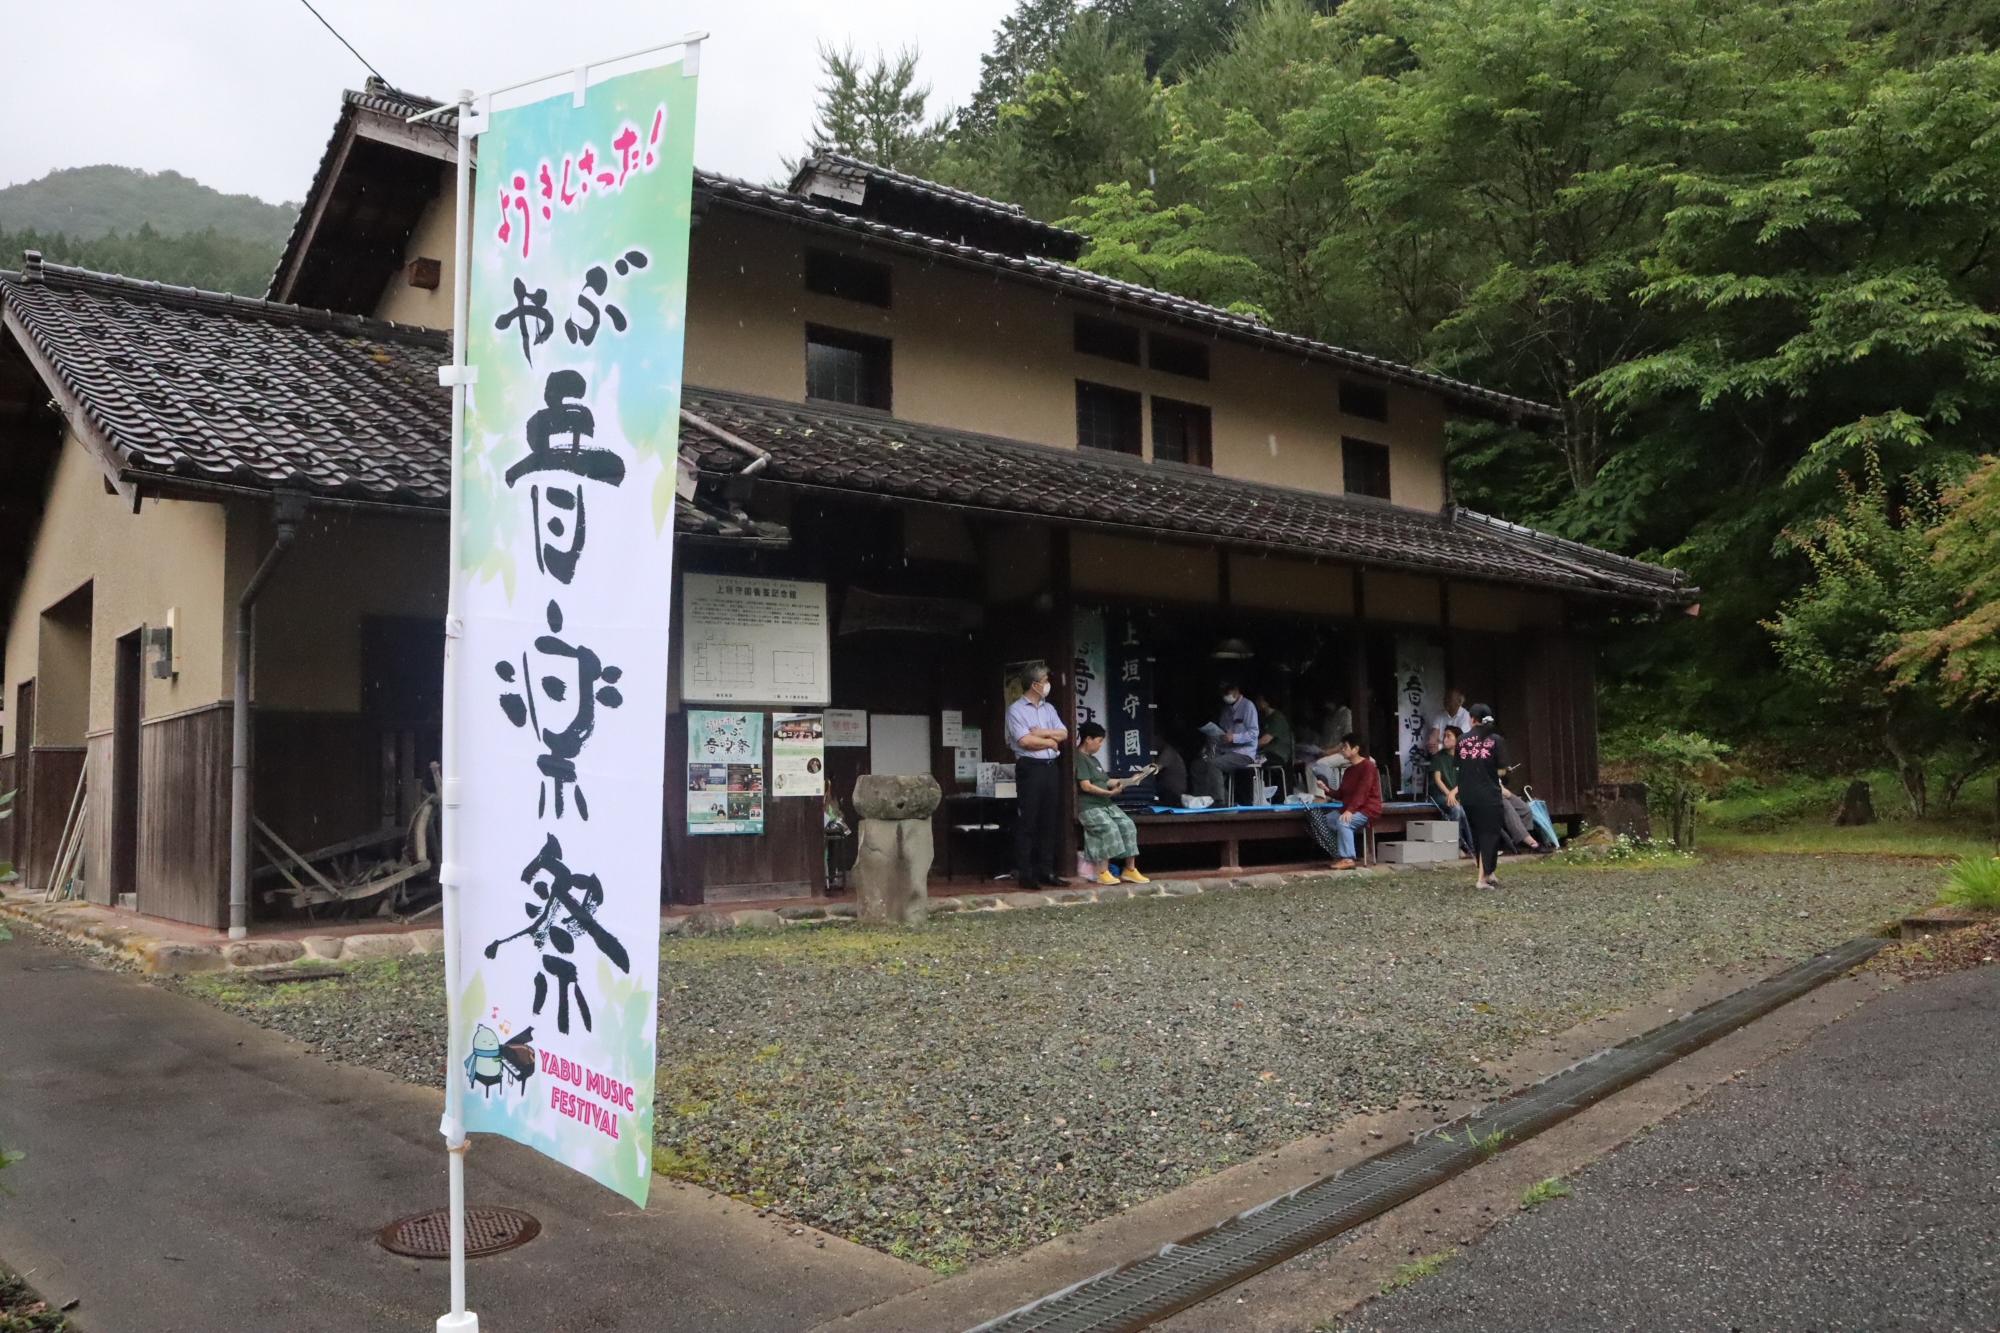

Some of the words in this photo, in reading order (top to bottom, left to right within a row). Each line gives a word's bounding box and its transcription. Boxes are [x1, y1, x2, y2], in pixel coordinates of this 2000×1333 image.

[495, 250, 648, 368] やぶ
[484, 370, 630, 1034] 音楽祭
[1122, 620, 1143, 771] 上垣守國
[704, 737, 750, 755] 音楽祭
[539, 1049, 582, 1086] YABU
[586, 1069, 634, 1112] MUSIC
[551, 1087, 619, 1139] FESTIVAL
